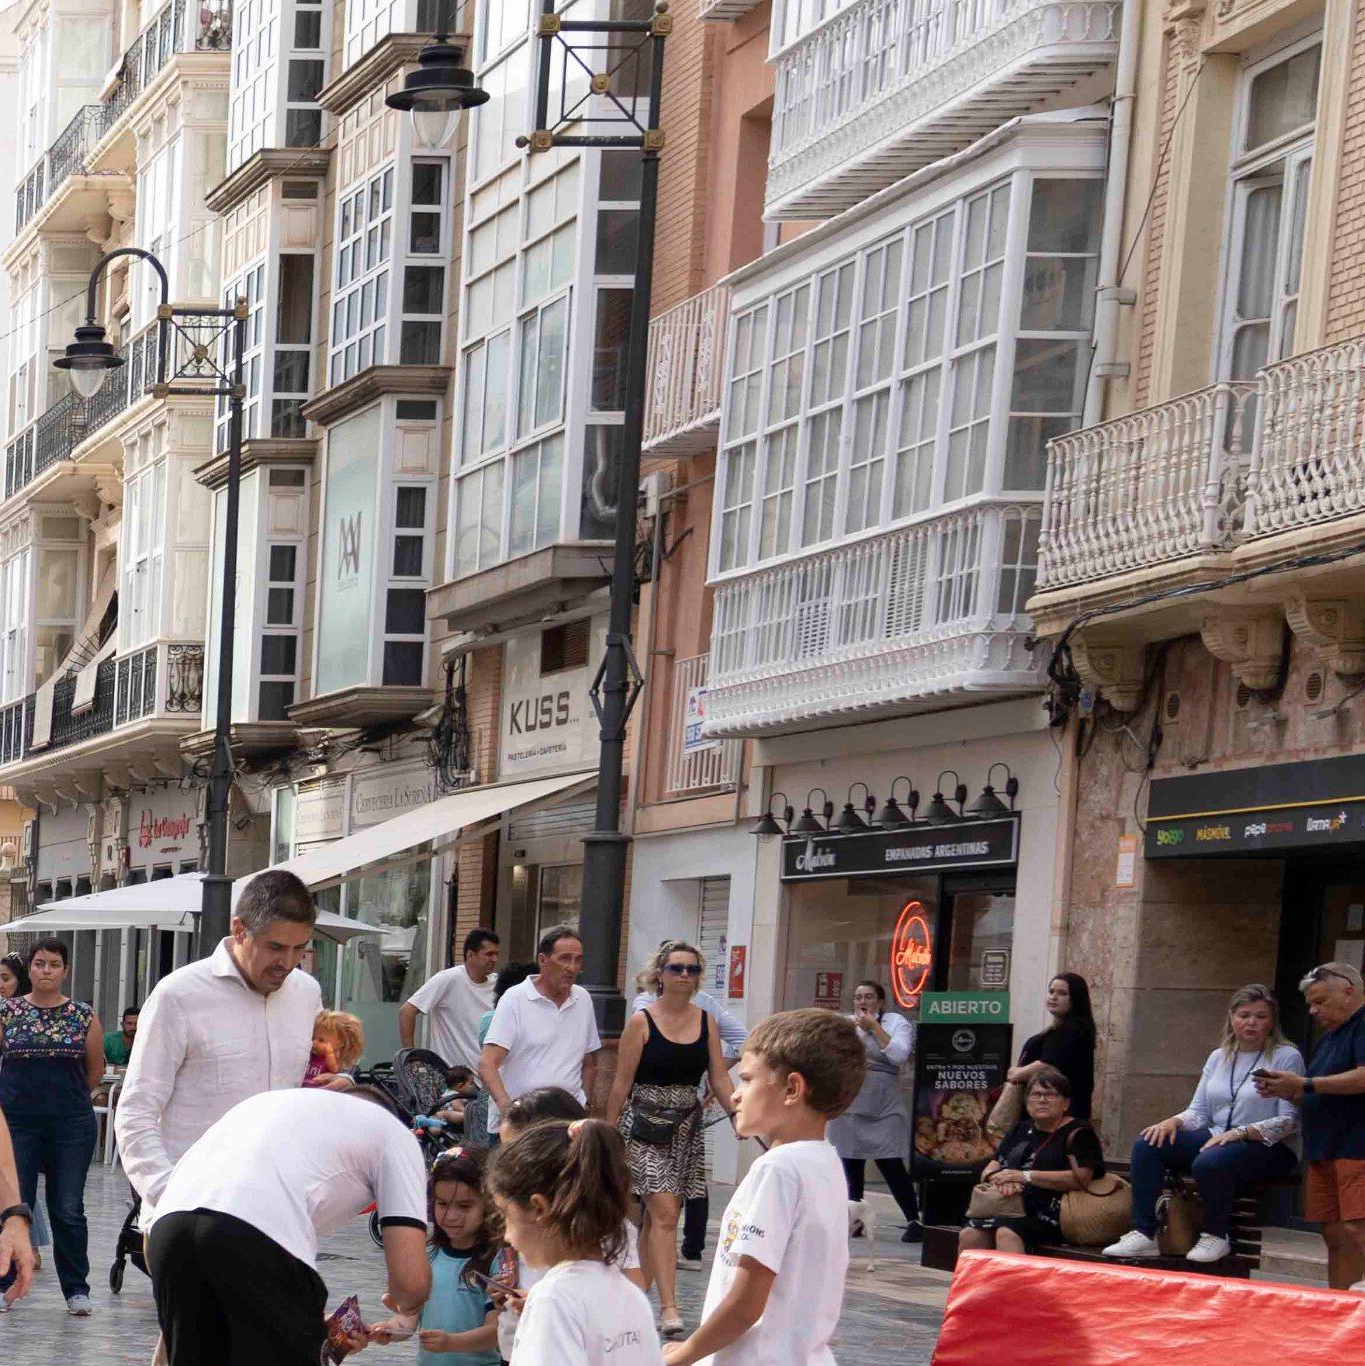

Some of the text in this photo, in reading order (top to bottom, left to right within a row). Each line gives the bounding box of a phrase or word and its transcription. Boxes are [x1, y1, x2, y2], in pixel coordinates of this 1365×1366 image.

[929, 1001, 1001, 1014] ABIERTO
[938, 1071, 986, 1080] NUEVOS
[934, 1081, 988, 1089] SABORES
